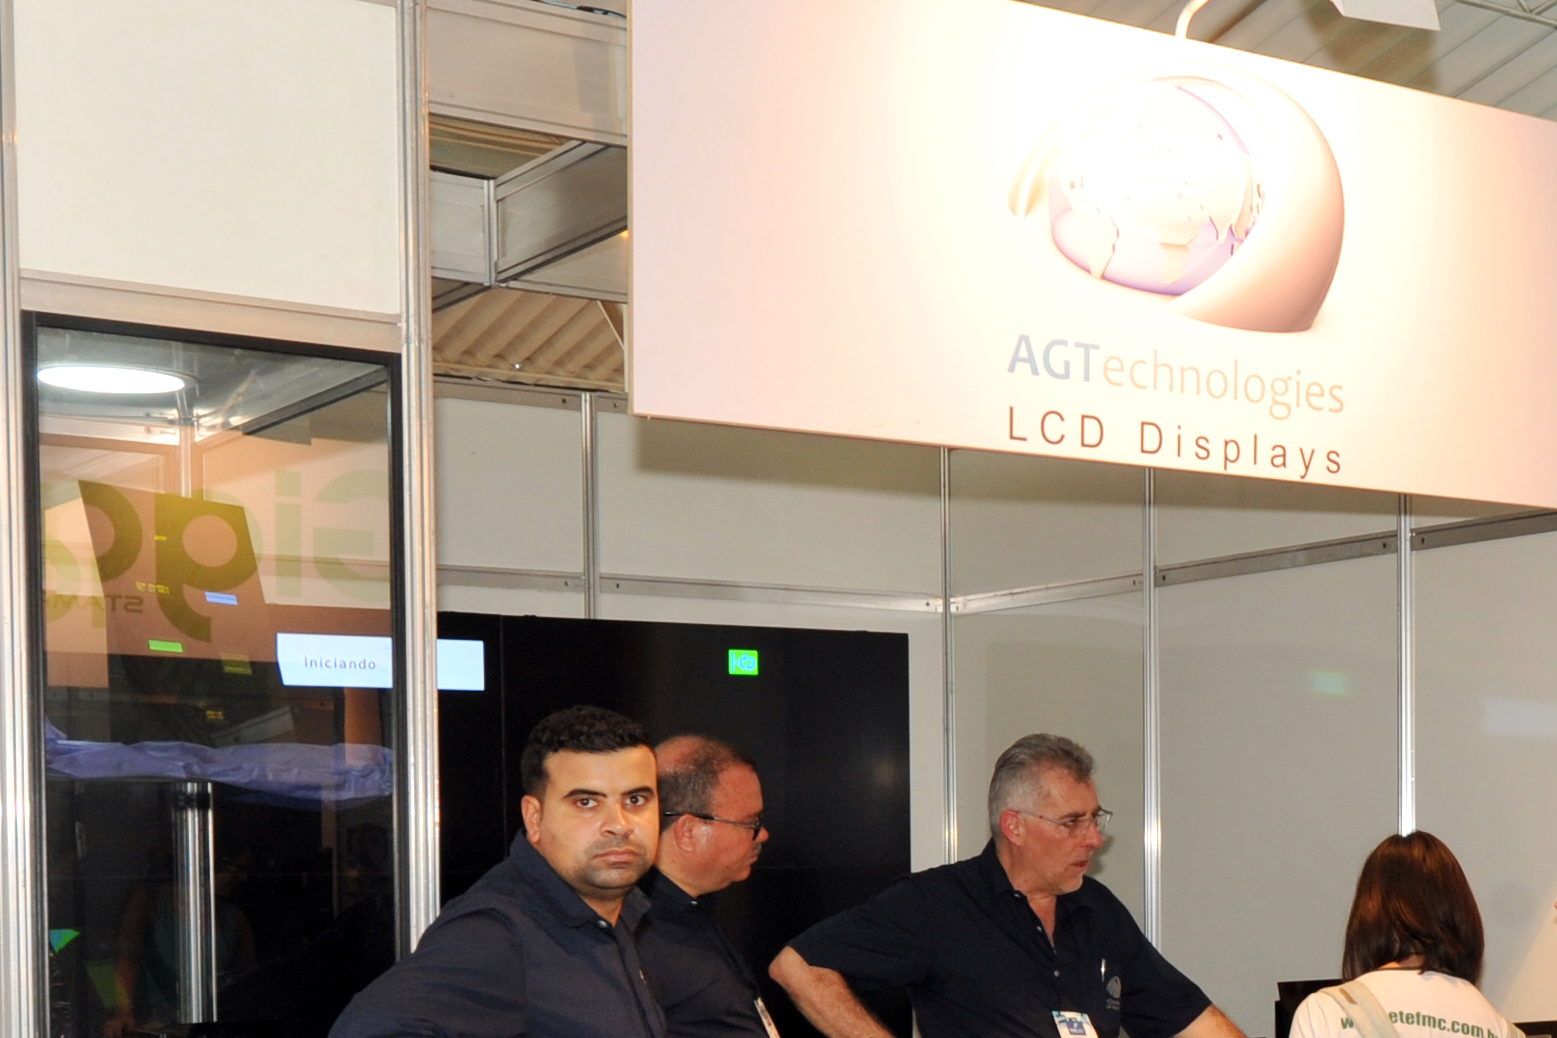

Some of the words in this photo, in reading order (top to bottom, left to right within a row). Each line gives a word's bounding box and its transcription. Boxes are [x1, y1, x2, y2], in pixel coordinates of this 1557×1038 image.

[1007, 334, 1344, 420] AGTechnologies
[1008, 406, 1105, 448] LCD
[1140, 421, 1341, 479] Displays
[304, 656, 376, 670] Iniciando
